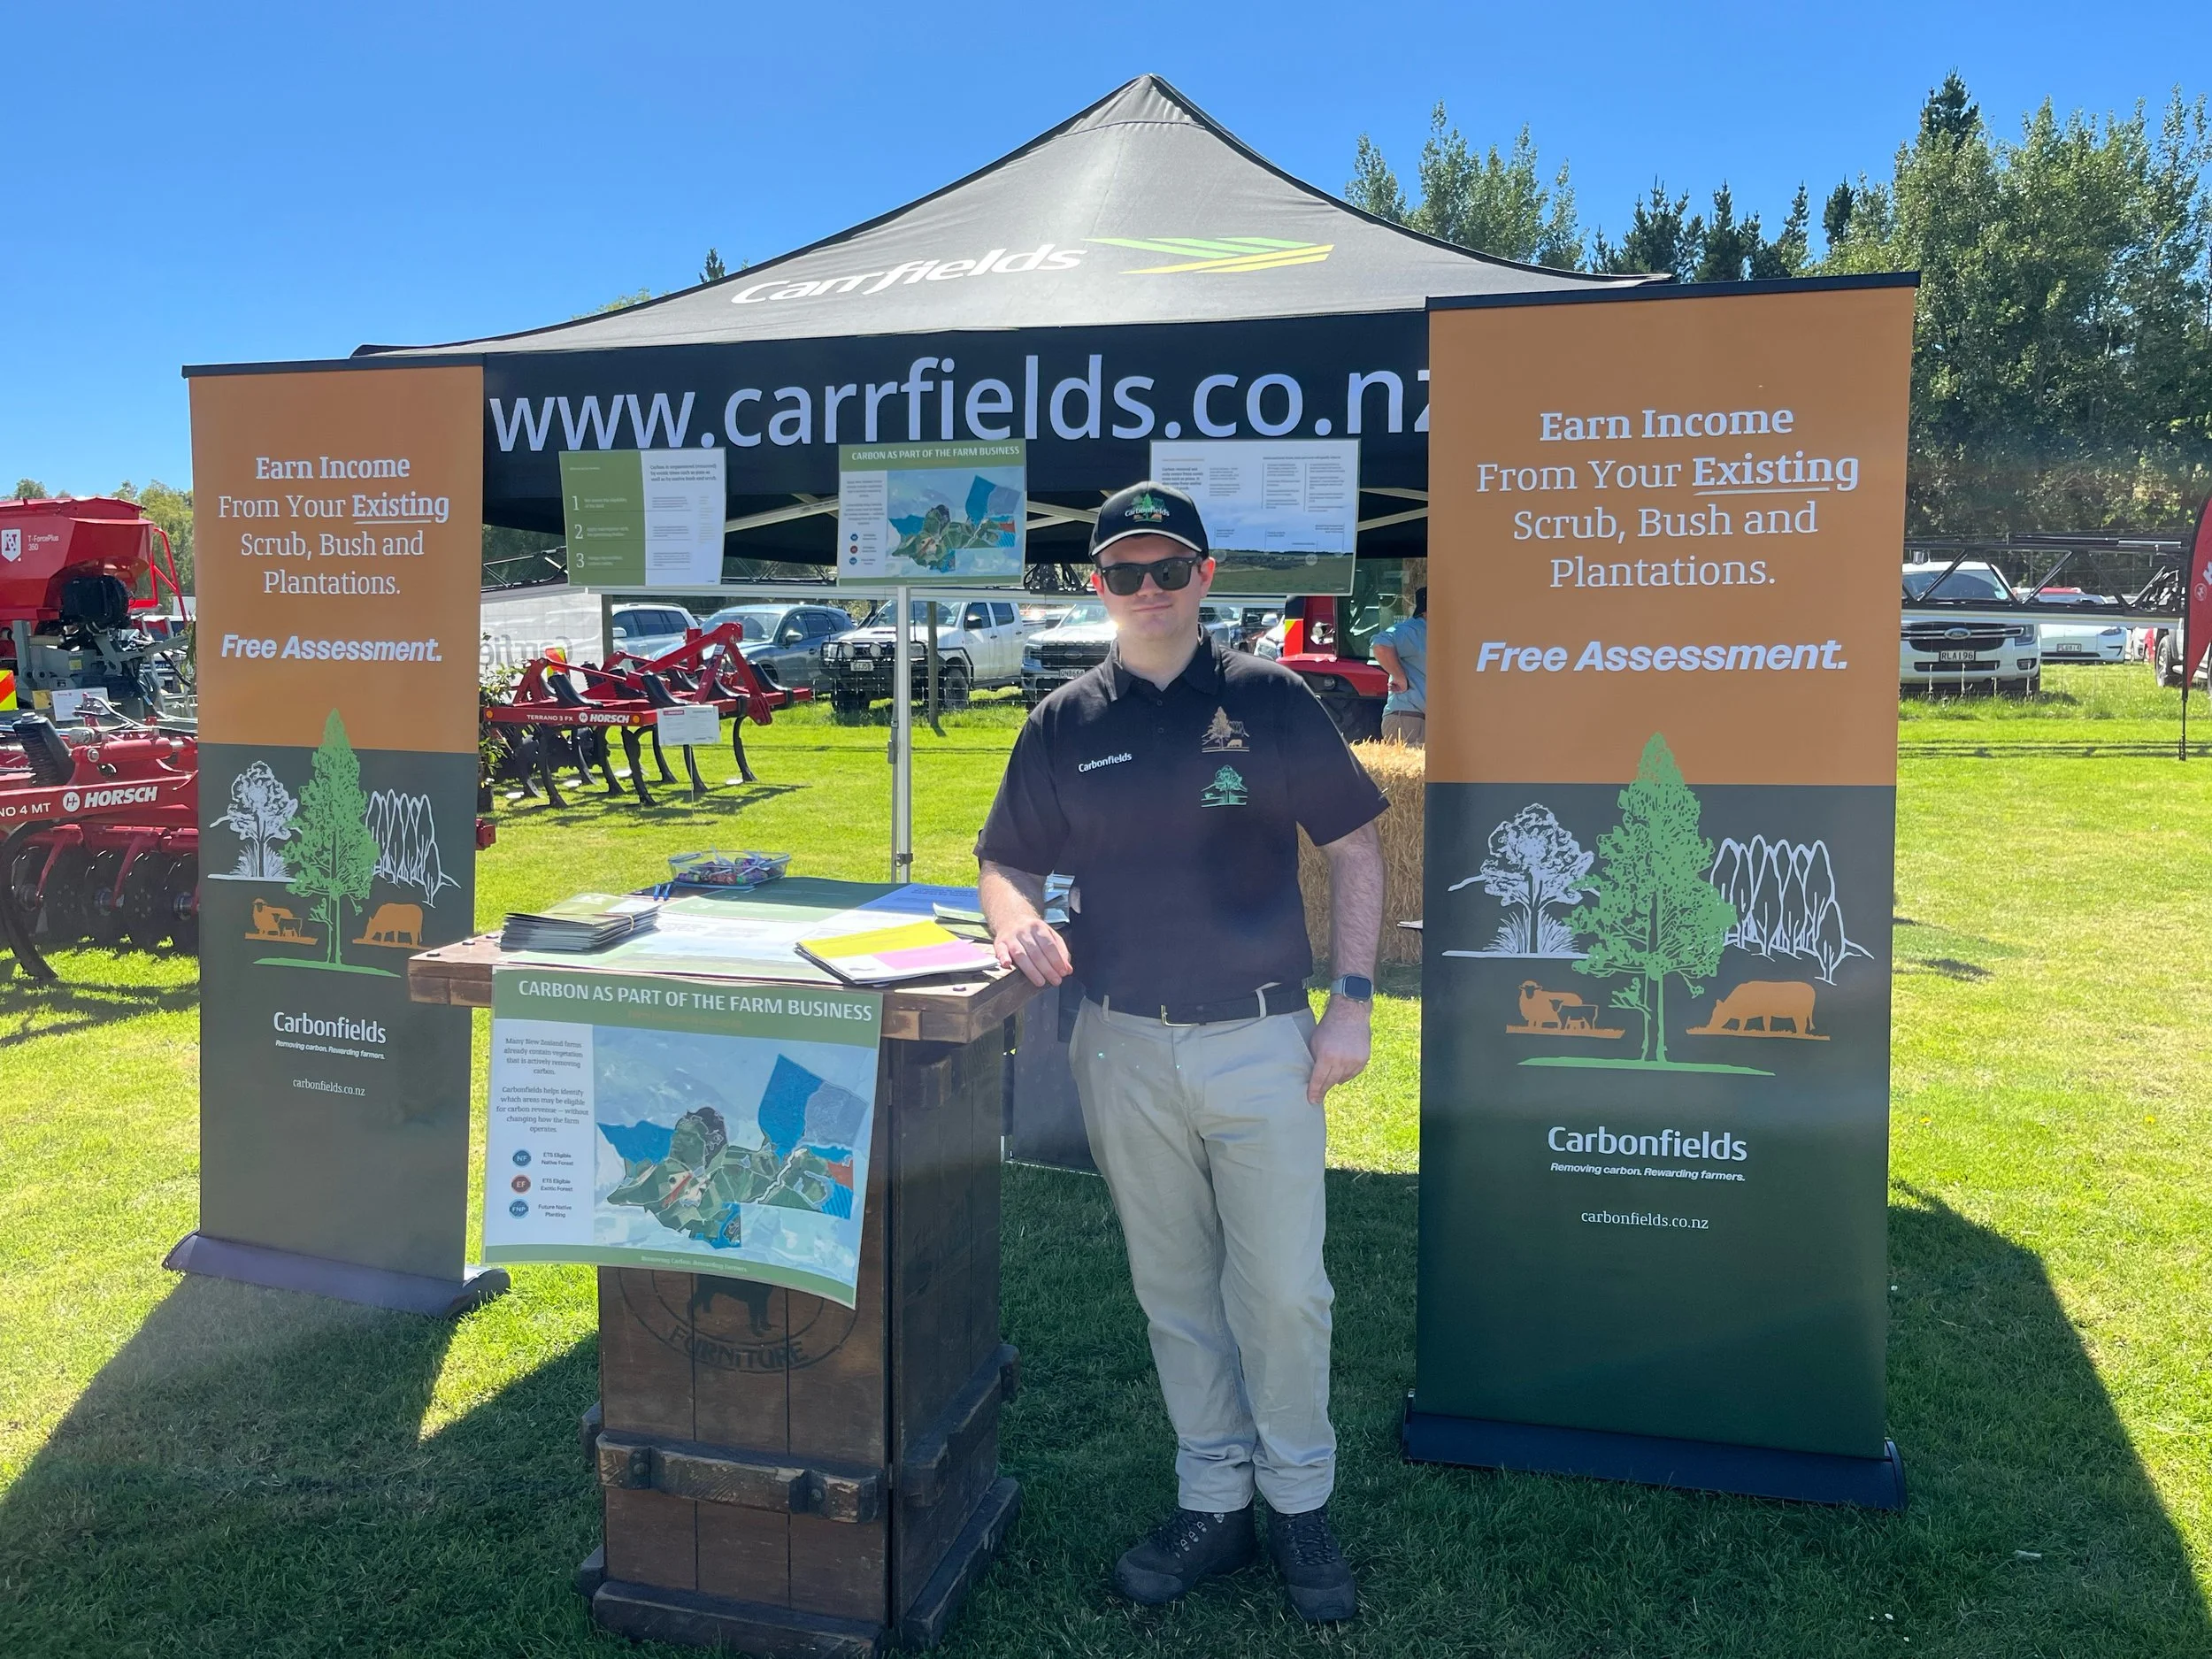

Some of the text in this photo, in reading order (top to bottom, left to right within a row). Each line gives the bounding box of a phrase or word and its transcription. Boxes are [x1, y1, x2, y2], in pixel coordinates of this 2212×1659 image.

[1540, 408, 1794, 442] Earn Income
[852, 445, 1019, 460] CARBON AS PART OF THE FARM BUSINESS
[256, 456, 411, 480] Earn Income
[1477, 450, 1858, 492] From Your Existing
[219, 491, 449, 523] From Your Existing
[572, 495, 580, 511] 1
[575, 524, 584, 540] 2
[1514, 501, 1818, 544] Scrub, Bush and
[241, 530, 424, 561] Scrub, Bush and
[576, 553, 585, 568] 3
[1550, 555, 1776, 588] Plantations.
[264, 569, 401, 595] Plantations.
[221, 634, 442, 661] Free Assessment.
[1476, 640, 1847, 672] Free Assessment.
[1941, 651, 1974, 661] RLA196
[589, 713, 629, 723] HORSCH
[1079, 752, 1132, 773] Carbonfields
[19, 805, 28, 814] 4
[31, 803, 51, 814] MT
[84, 786, 158, 809] HORSCH
[518, 979, 872, 1022] CARBON AS PART OF THE FARM BUSINESS
[273, 1011, 387, 1044] Carbonfields
[275, 1040, 386, 1060] Removing carbon. Rewarding farmers.
[293, 1078, 365, 1097] carbonfields.co.nz
[502, 1086, 542, 1094] Carbonfields
[506, 1115, 537, 1125] changing
[1548, 1125, 1747, 1162] Carbonfields
[1550, 1162, 1746, 1181] Removing carbon. Rewarding farmers.
[1581, 1210, 1709, 1230] carbonfields.co.nz
